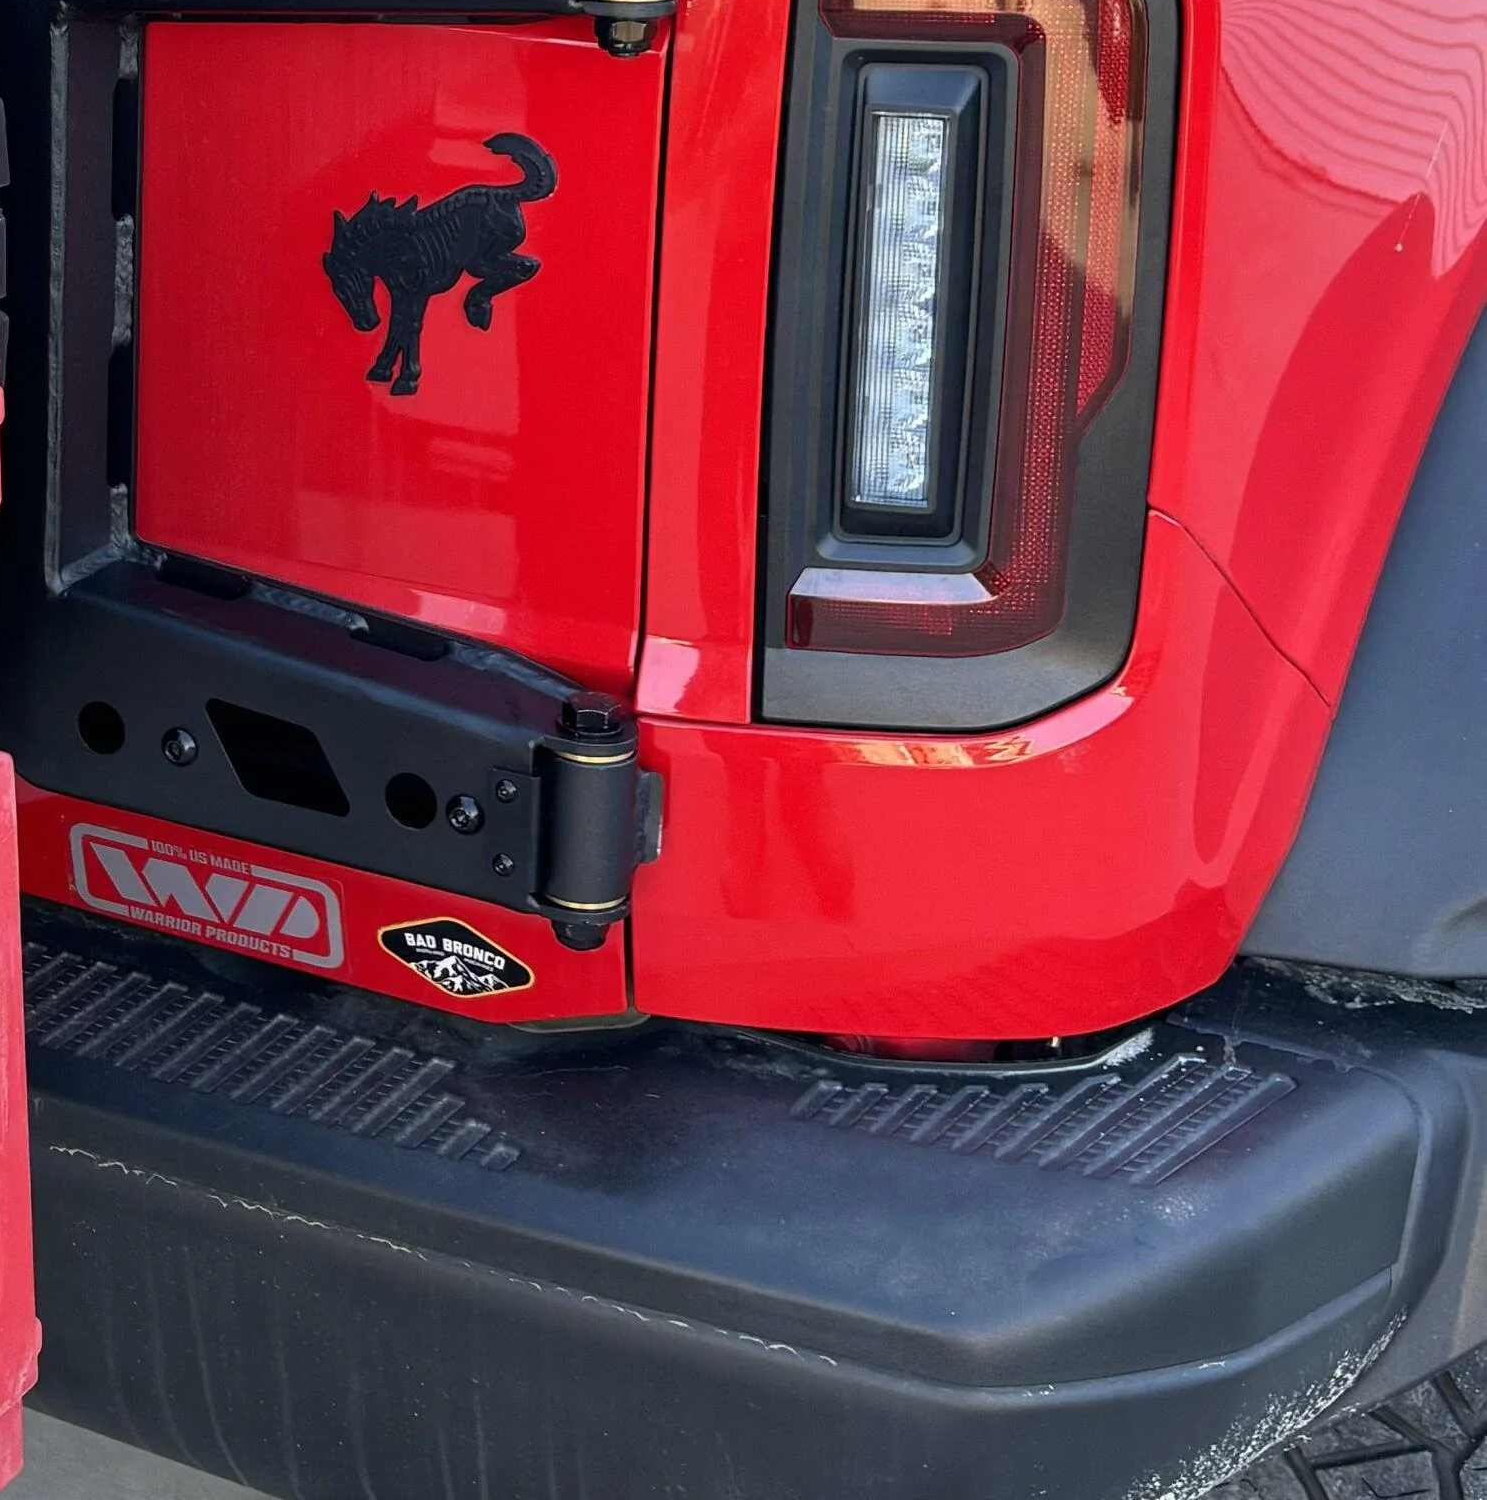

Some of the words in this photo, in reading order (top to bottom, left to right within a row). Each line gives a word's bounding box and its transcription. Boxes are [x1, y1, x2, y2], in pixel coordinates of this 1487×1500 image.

[150, 839, 188, 860] 100%
[189, 850, 208, 865] US
[210, 855, 251, 875] MADE
[129, 905, 203, 936] WARRIOR
[205, 926, 292, 959] PRODUCTS
[404, 932, 437, 949] BAD
[442, 938, 506, 970] BRONCO
